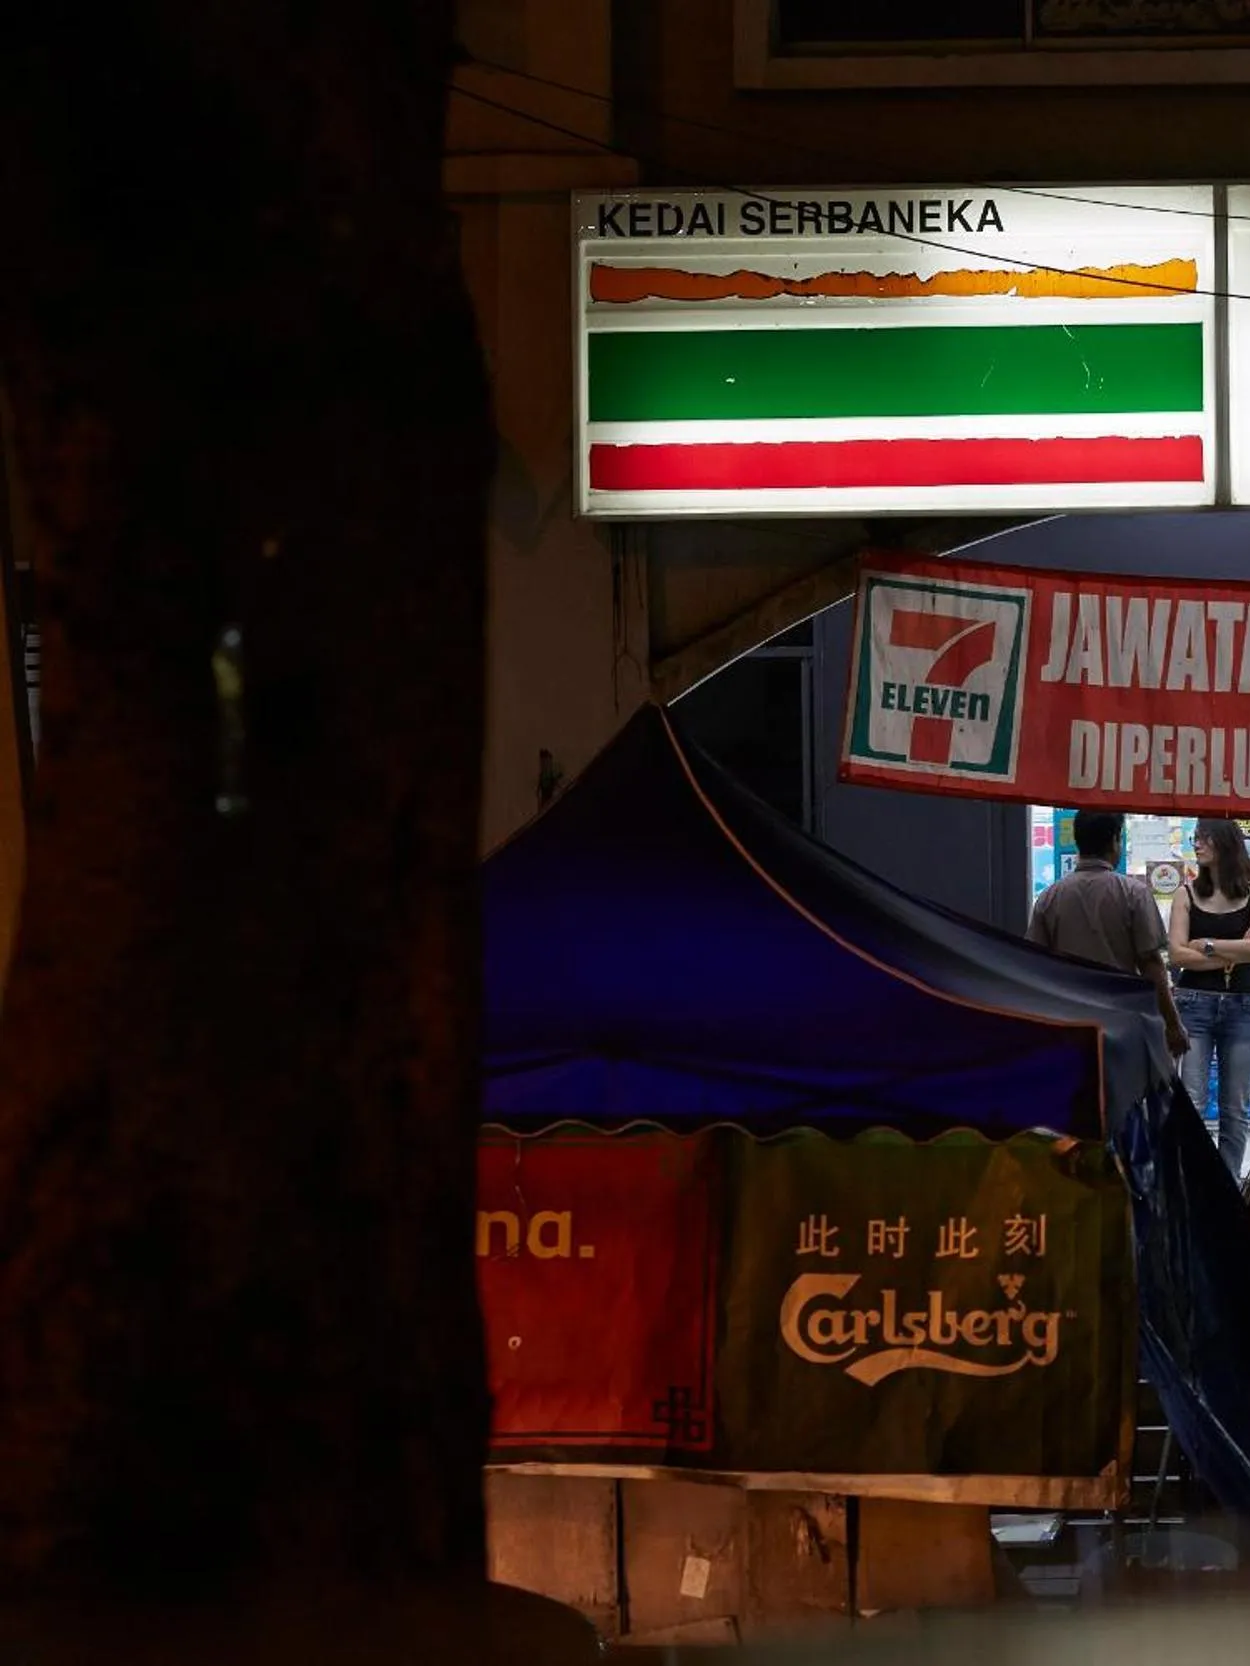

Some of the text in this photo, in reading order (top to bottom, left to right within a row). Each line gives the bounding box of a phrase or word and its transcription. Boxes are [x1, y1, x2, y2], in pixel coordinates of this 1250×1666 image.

[597, 199, 1004, 238] KEDAI SERBANEKA
[795, 1212, 1047, 1258] 此时此刻
[779, 1272, 1061, 1387] Carlsberg
